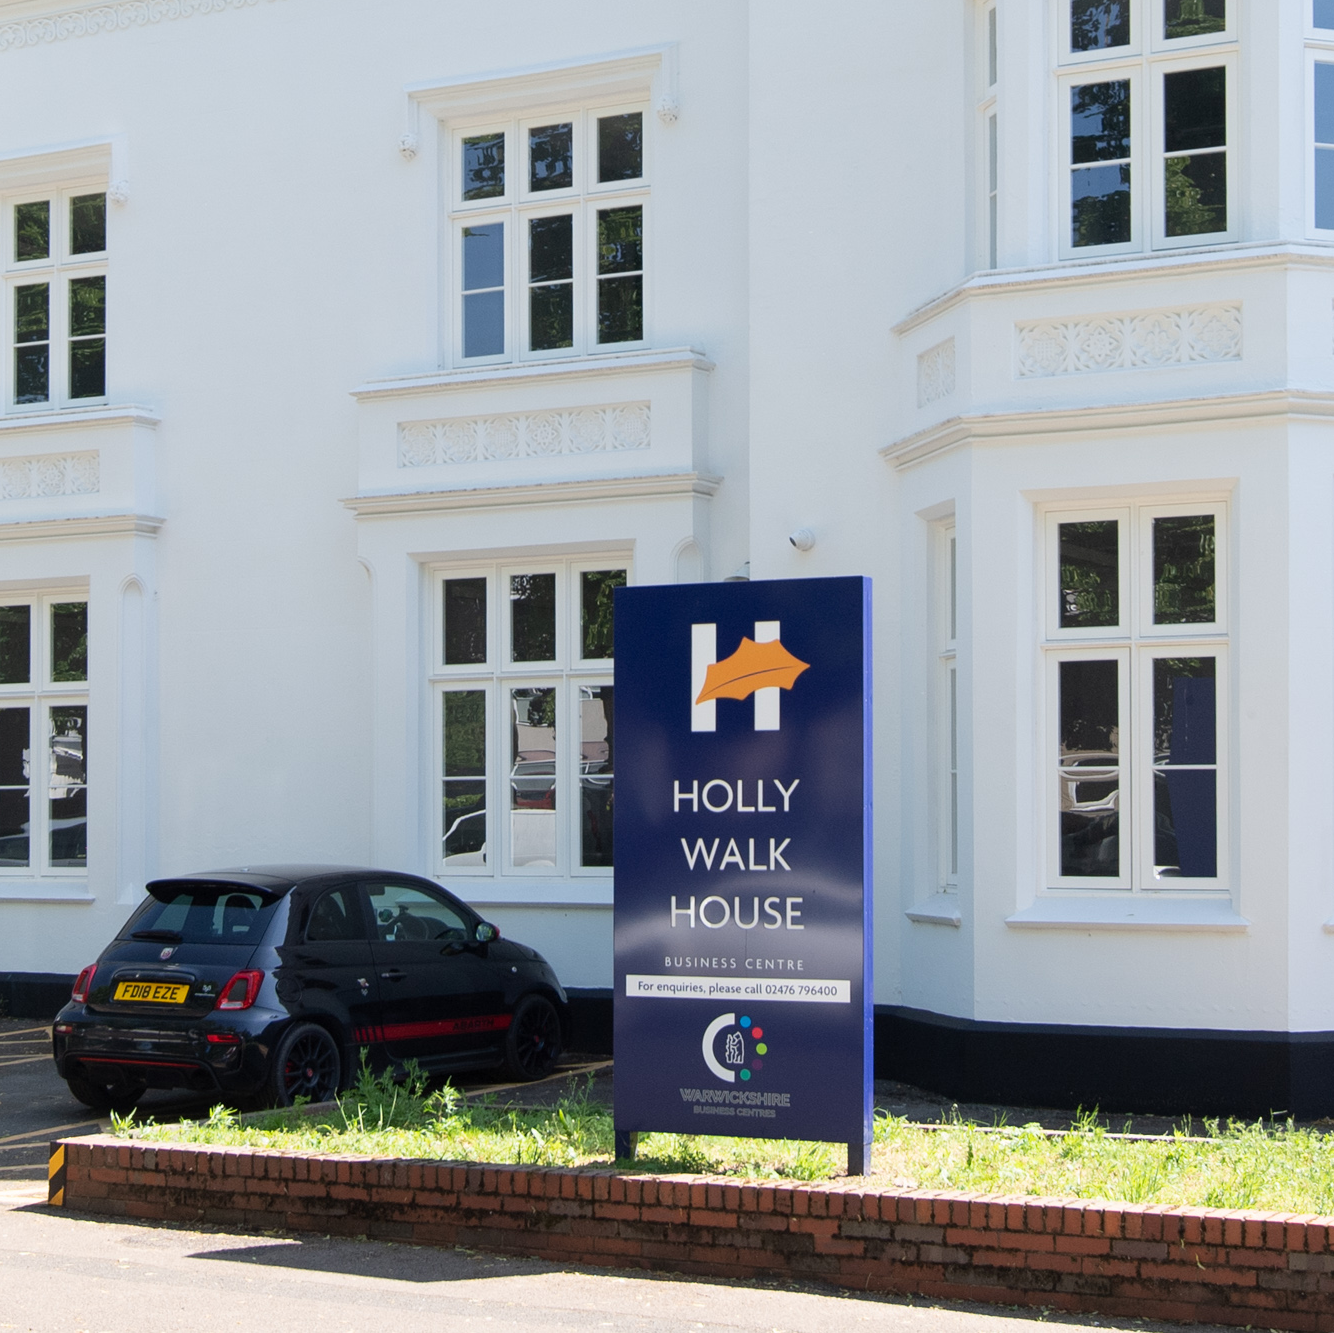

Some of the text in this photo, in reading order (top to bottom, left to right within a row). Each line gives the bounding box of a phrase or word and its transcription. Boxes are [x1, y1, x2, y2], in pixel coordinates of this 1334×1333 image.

[673, 779, 800, 813] HOLLY
[680, 837, 792, 871] WALK
[670, 895, 805, 930] HOUSE
[664, 956, 804, 971] BUSINESS CENTRE
[121, 984, 151, 998] FD18
[152, 986, 180, 1000] EZE
[638, 981, 837, 996] For enquiries, please call 02476 796400
[679, 1088, 791, 1107] WARWICKSHIRE
[693, 1105, 776, 1118] BUSINESS CENTRES
